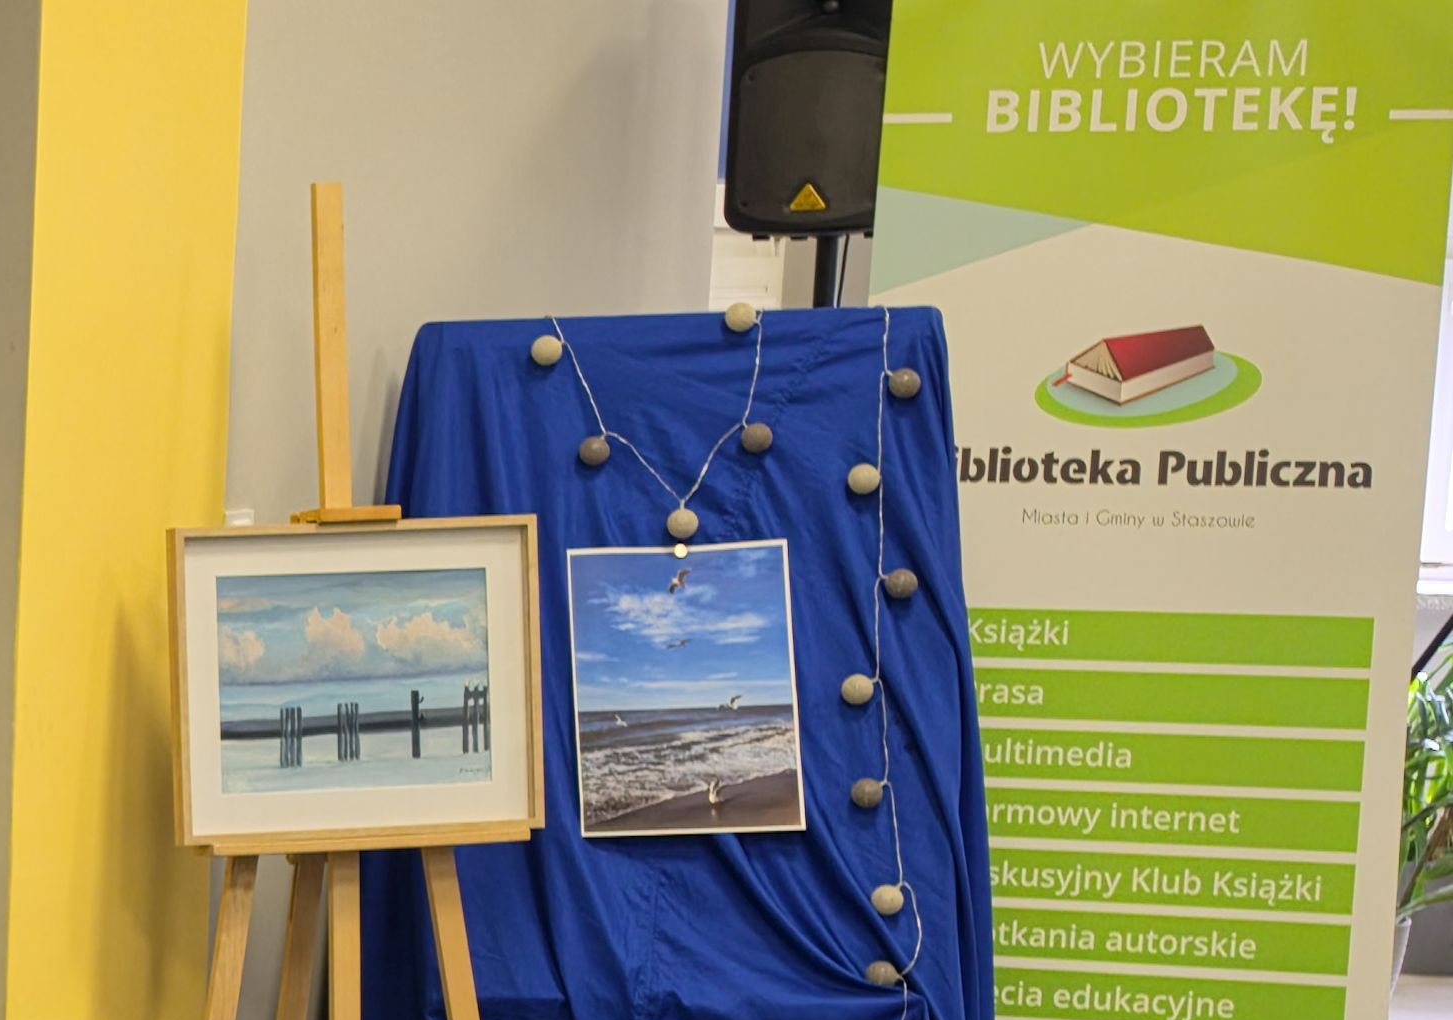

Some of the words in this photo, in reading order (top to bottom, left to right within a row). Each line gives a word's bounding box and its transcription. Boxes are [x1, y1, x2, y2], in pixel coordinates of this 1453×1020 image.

[1039, 38, 1308, 79] WYBIERAM
[986, 85, 1358, 144] BIBLIOTEKĘ!
[955, 446, 1141, 485] blioteka
[1158, 450, 1373, 488] Publiczna
[1022, 508, 1079, 526] Miasta
[1096, 509, 1145, 529] Gminy
[1171, 511, 1256, 528] Staszowie
[975, 680, 1044, 705] rasa
[983, 738, 1132, 768] ultimedia
[987, 801, 1101, 834] rmowy
[1110, 803, 1240, 833] internet
[990, 860, 1121, 898] skusyjny
[1131, 867, 1202, 896] Klub
[1213, 872, 1322, 906] Książki
[992, 920, 1095, 950] tkania
[1105, 930, 1257, 960] autorskie
